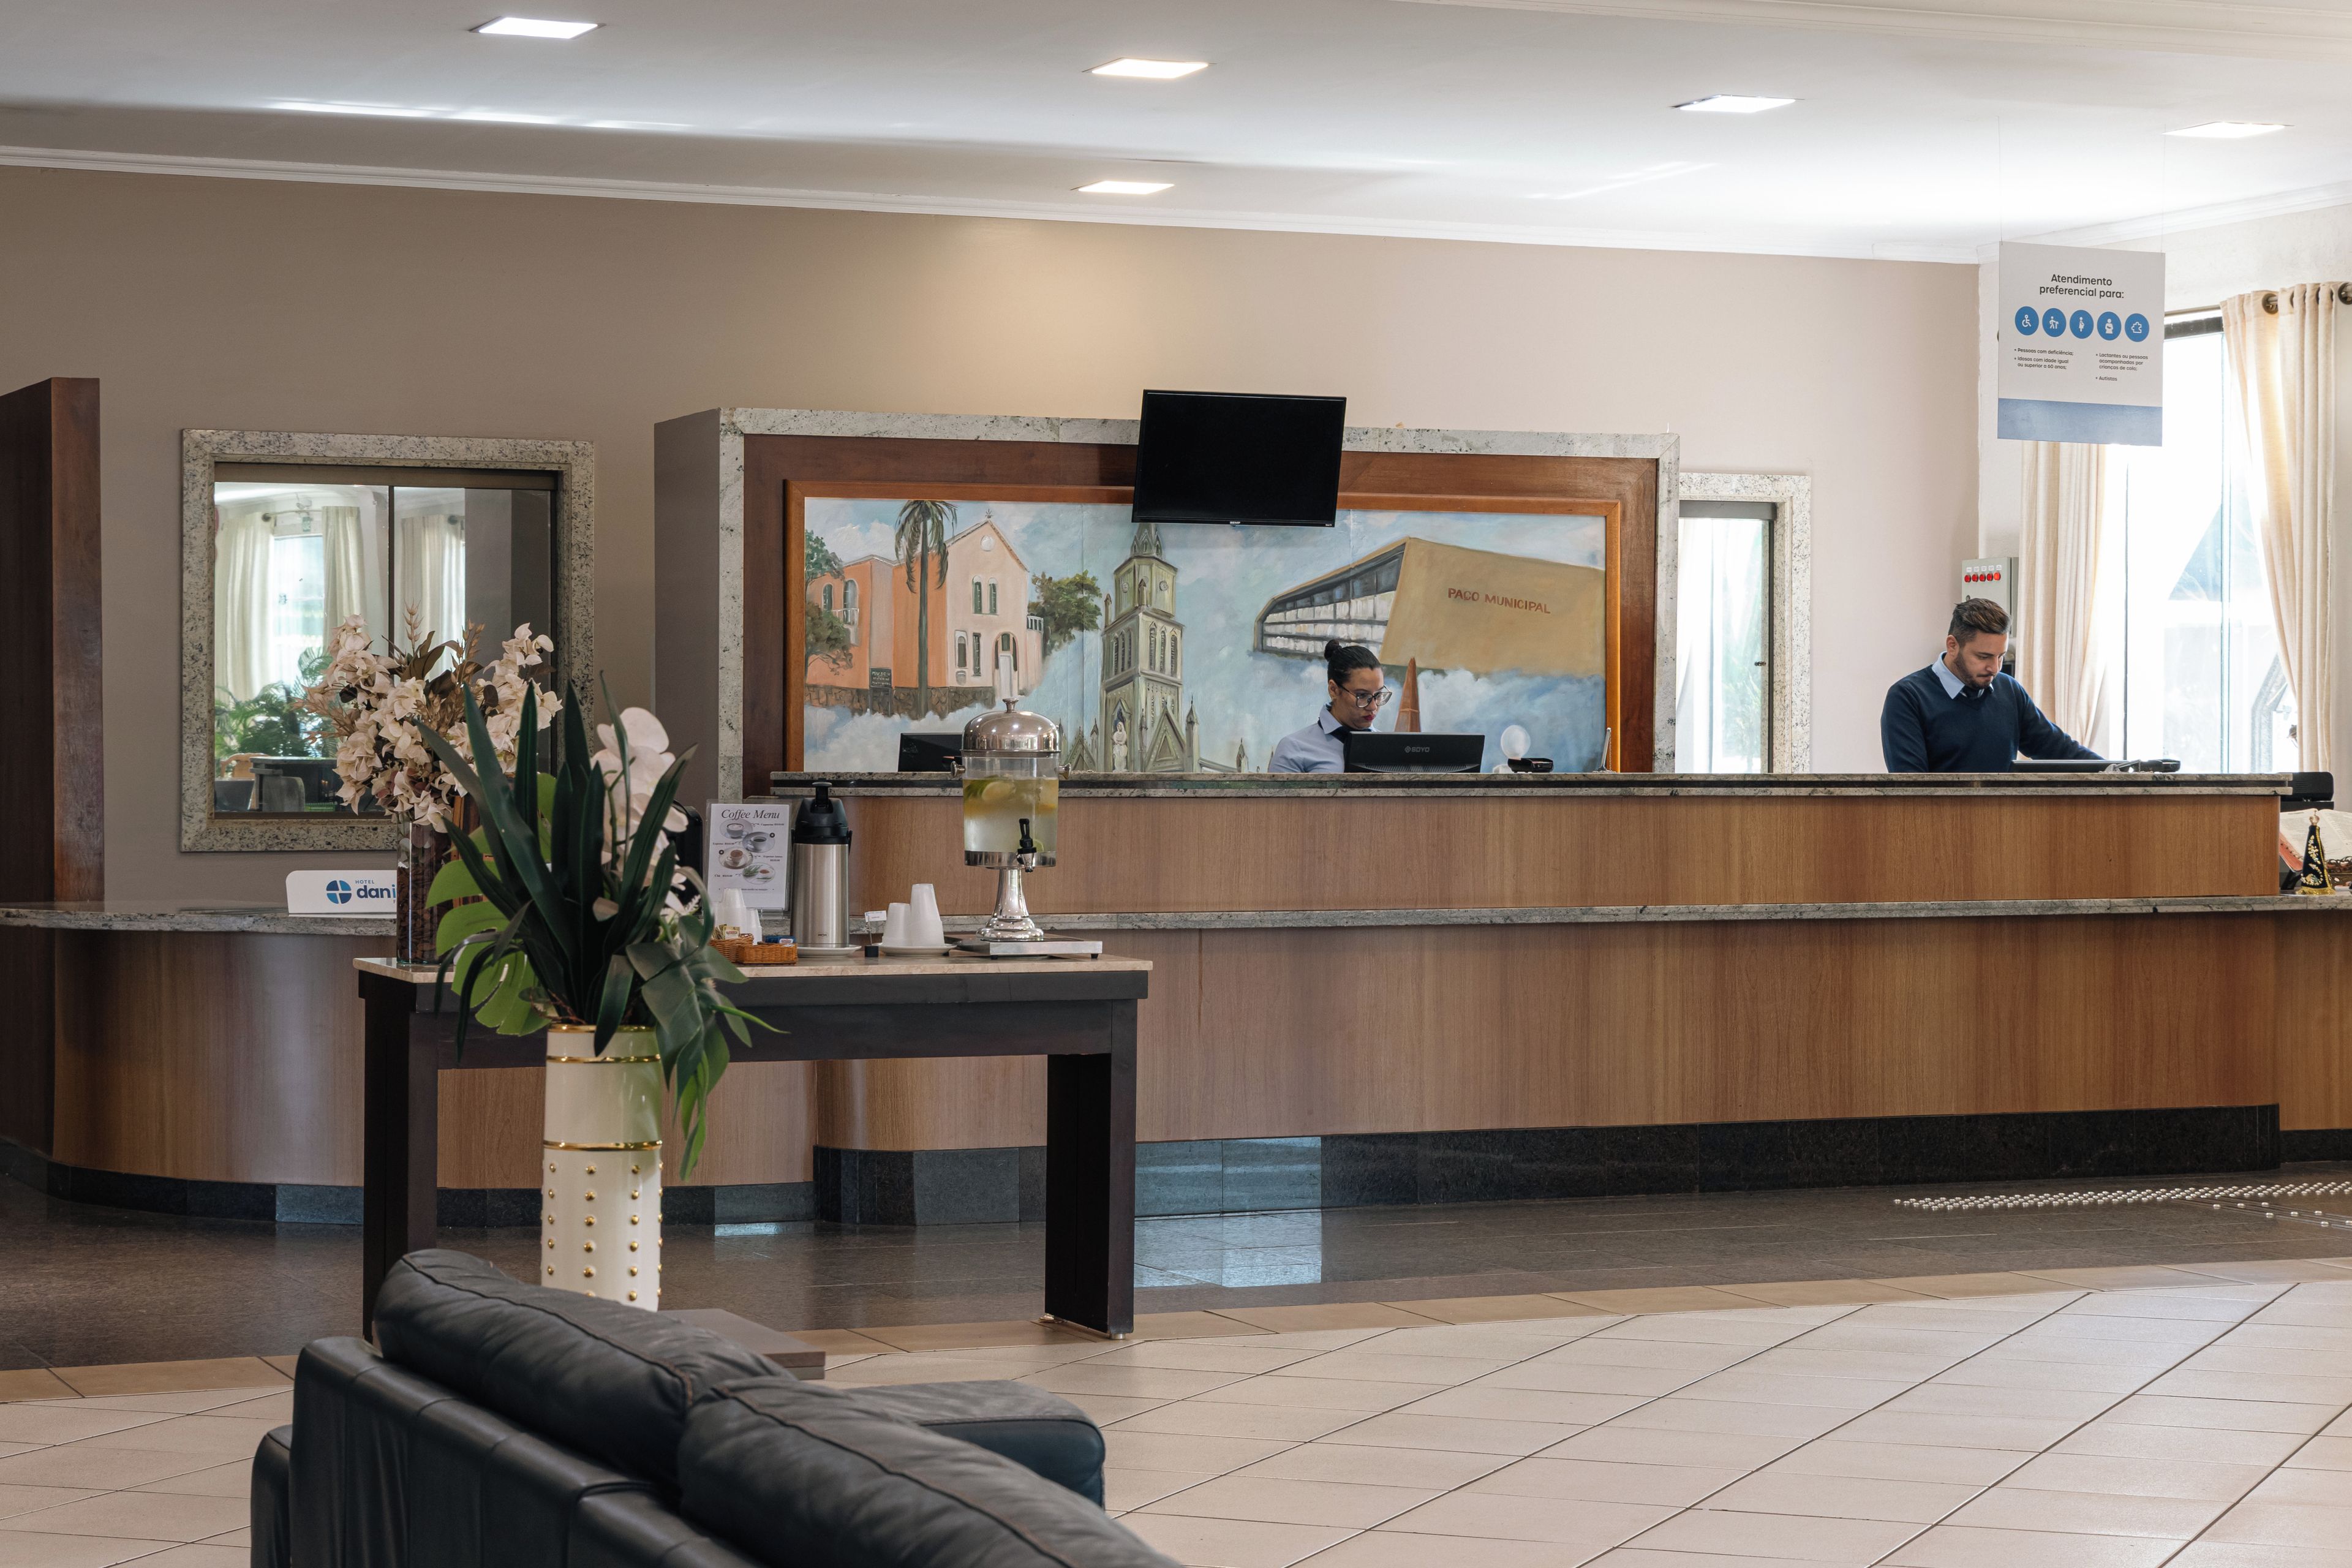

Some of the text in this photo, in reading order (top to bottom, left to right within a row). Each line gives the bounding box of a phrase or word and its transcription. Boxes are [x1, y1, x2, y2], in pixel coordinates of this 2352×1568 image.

[2051, 274, 2112, 286] Atendimento
[2040, 285, 2124, 299] preferencial para:
[1485, 594, 1550, 614] MUNICIPAL
[721, 809, 780, 820] Coffee Menu
